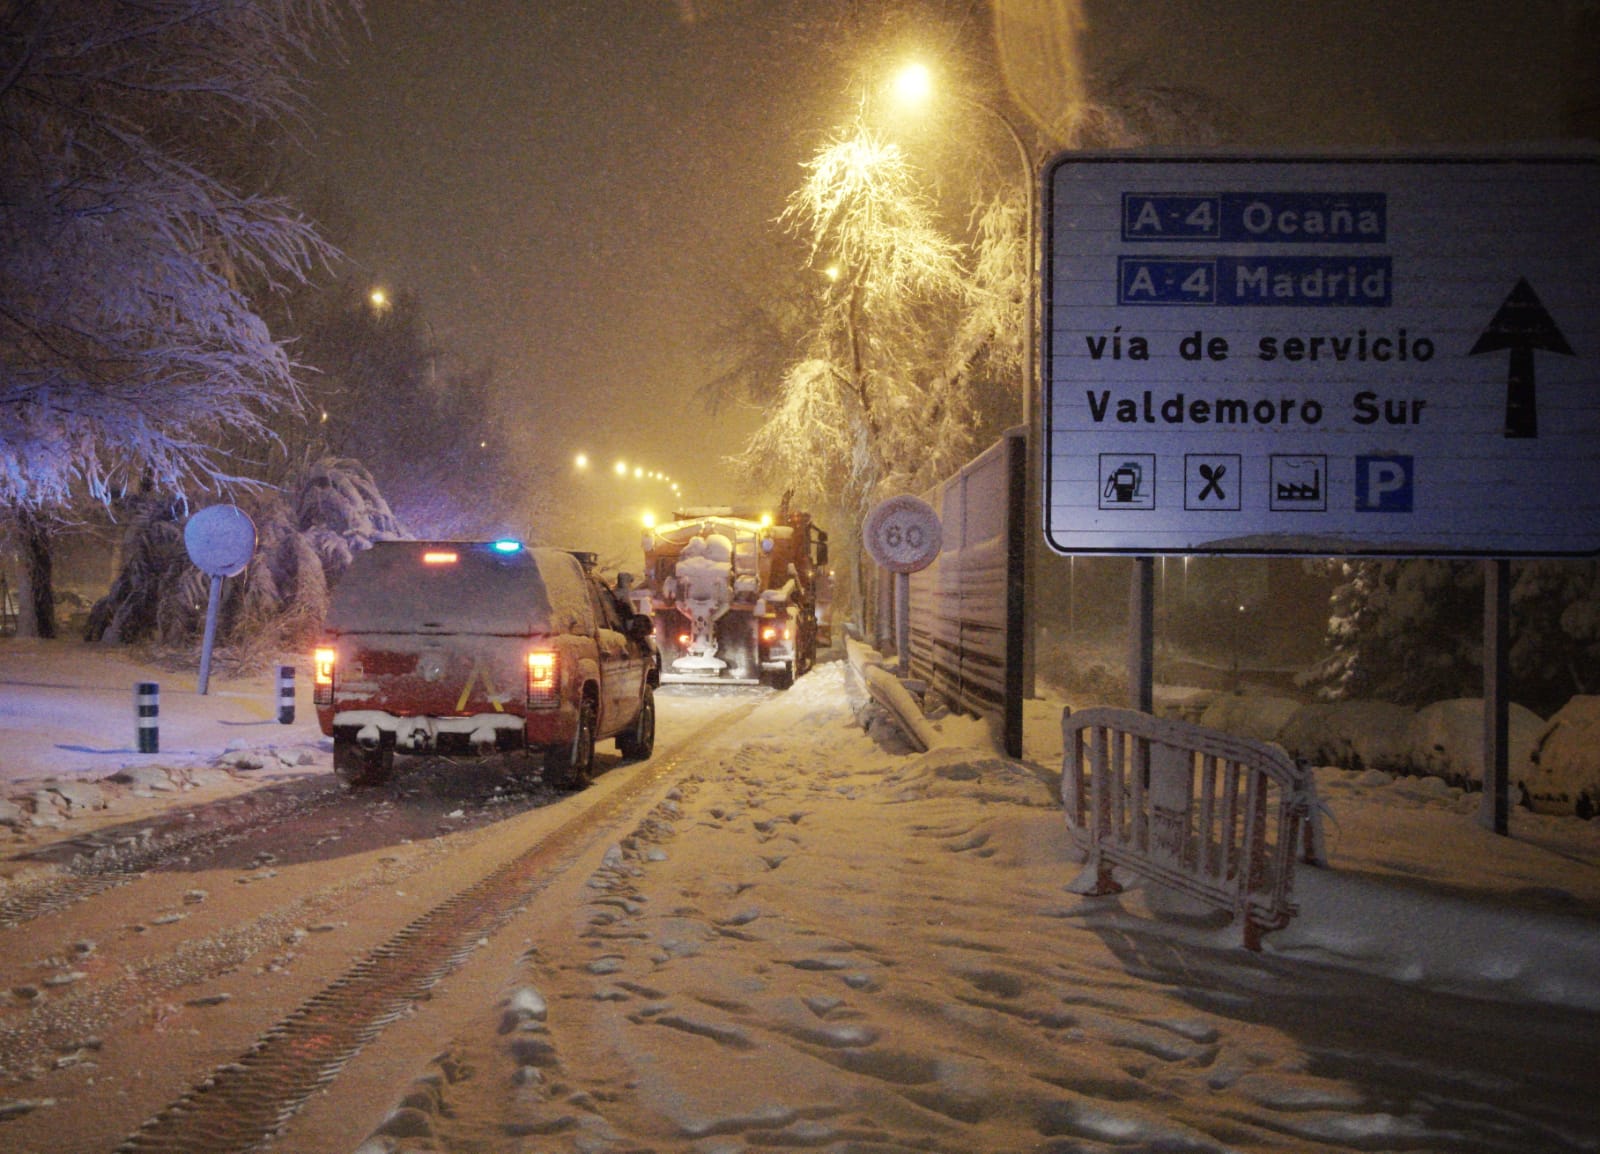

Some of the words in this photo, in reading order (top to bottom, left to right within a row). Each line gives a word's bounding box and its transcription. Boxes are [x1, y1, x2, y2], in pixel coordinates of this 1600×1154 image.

[1134, 202, 1215, 232] A-4
[1242, 202, 1381, 234] Ocaña
[1128, 266, 1210, 297] A-4
[1236, 264, 1386, 298] Madrid
[1086, 326, 1149, 361] vía
[1179, 331, 1230, 361] de
[1258, 329, 1435, 362] servicio
[1086, 391, 1323, 424] Valdemoro
[1352, 392, 1427, 424] Sur
[1368, 463, 1405, 506] P
